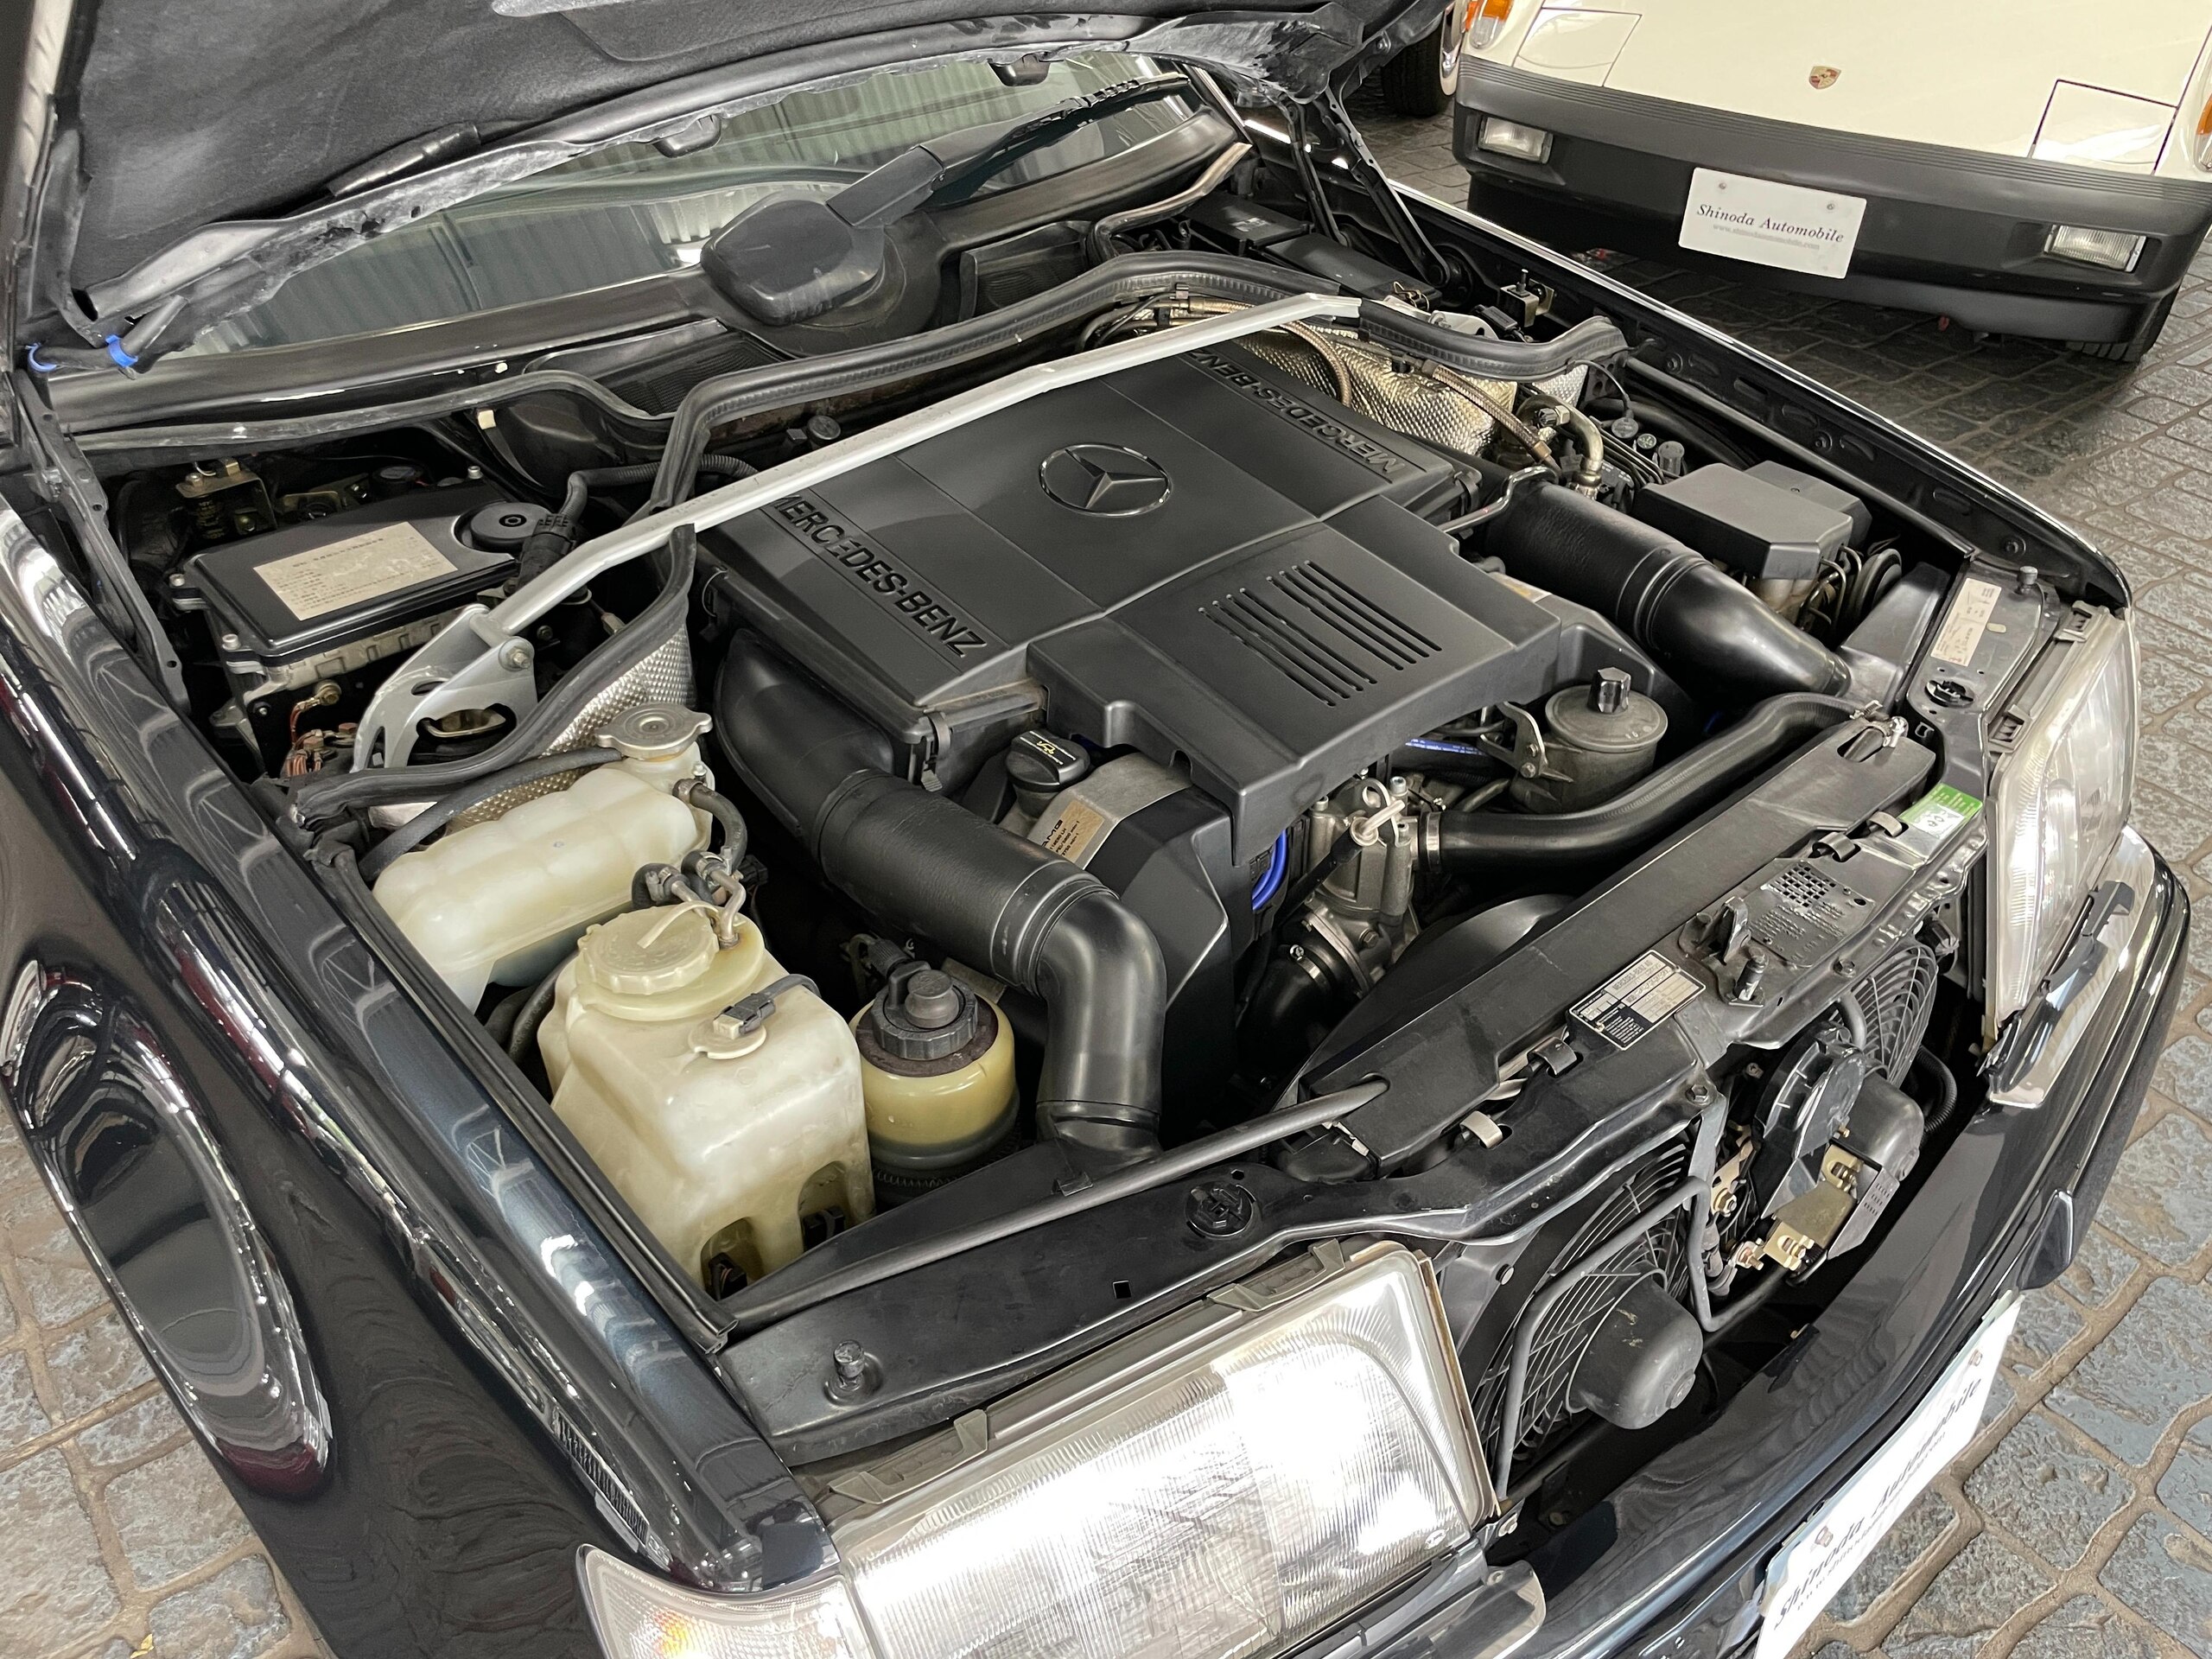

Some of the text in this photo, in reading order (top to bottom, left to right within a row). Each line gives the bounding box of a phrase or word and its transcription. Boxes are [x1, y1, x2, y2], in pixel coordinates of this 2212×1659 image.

[1696, 204, 1845, 244] Shinoda Automobile
[1774, 1516, 1865, 1630] Shinoda
[1870, 1378, 1981, 1518] Automobile
